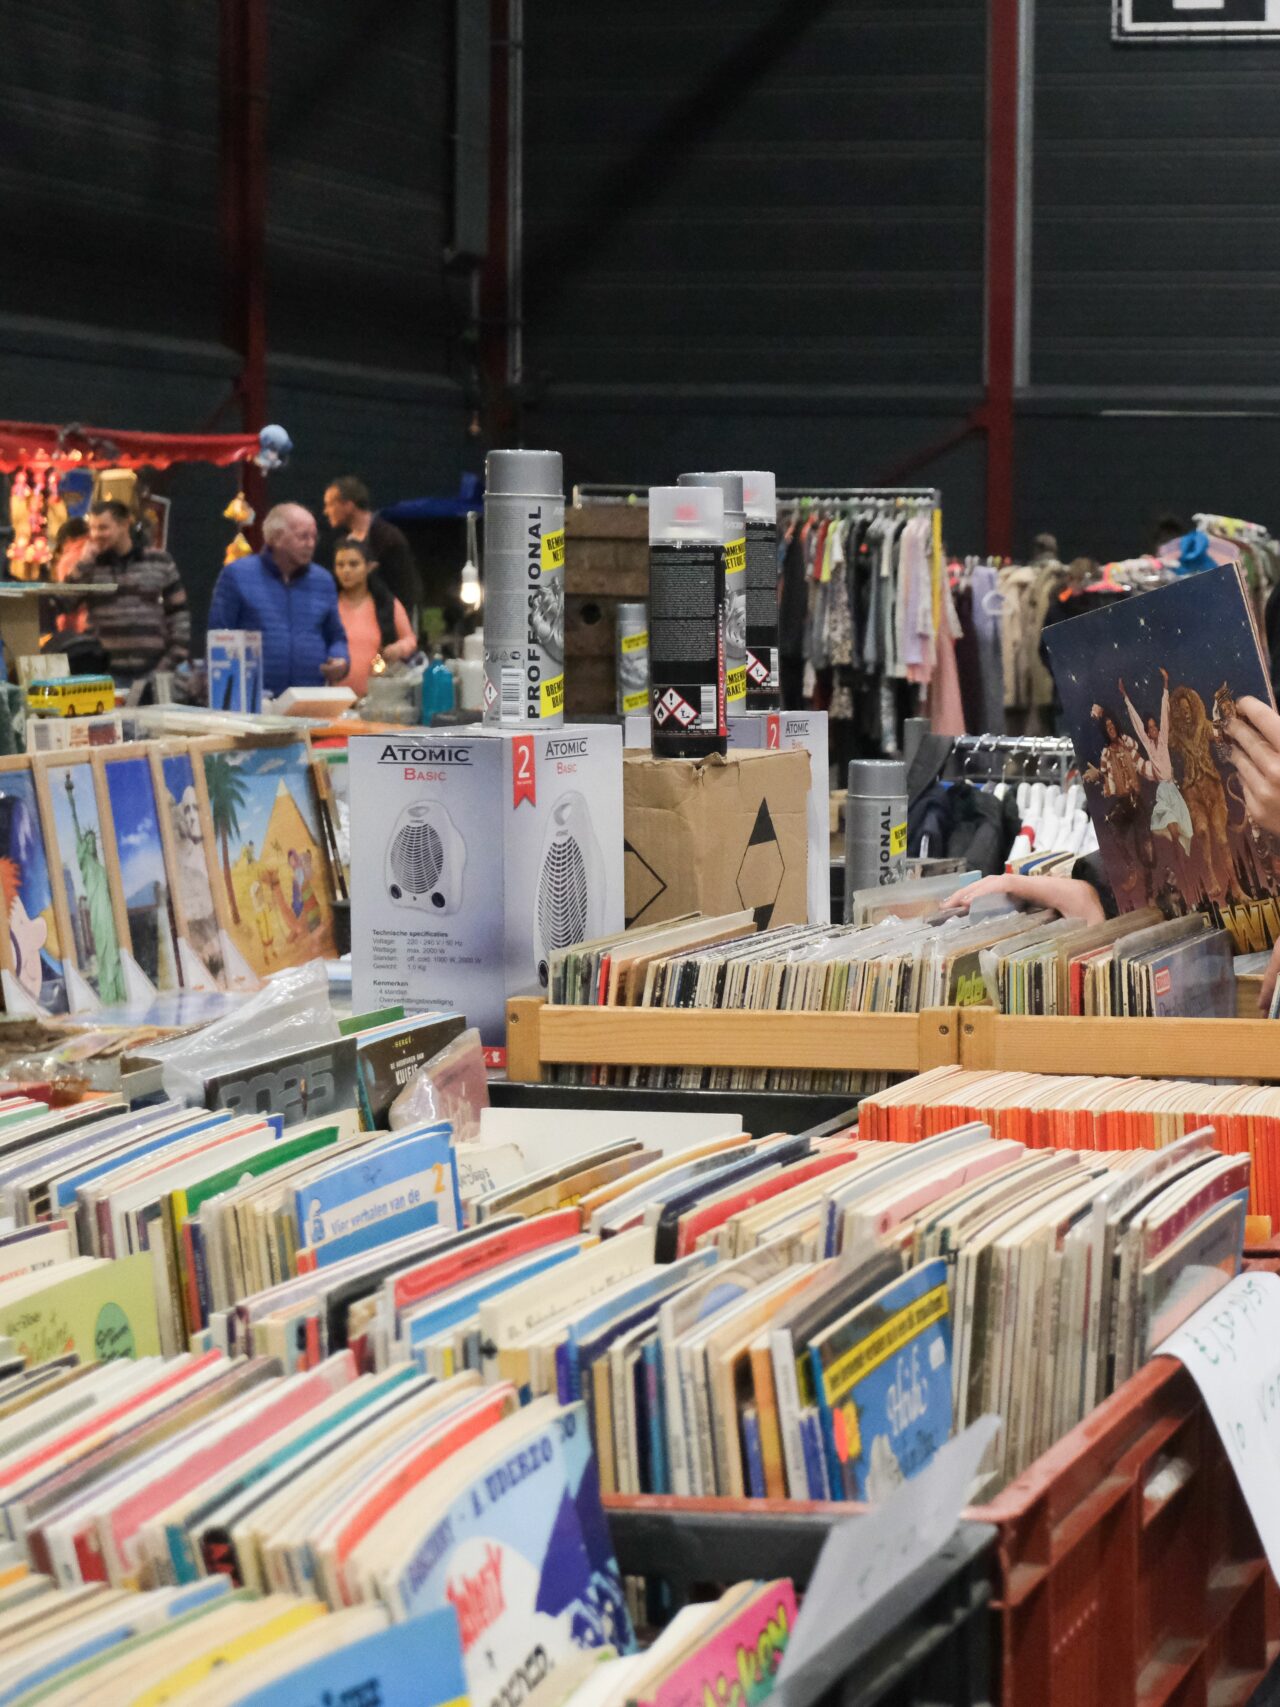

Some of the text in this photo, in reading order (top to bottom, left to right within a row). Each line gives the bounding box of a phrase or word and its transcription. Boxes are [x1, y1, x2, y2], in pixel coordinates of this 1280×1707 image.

[786, 721, 809, 734] ATOMIC
[770, 725, 778, 749] 2
[380, 744, 470, 762] ATOMIC
[545, 740, 587, 756] ATOMIC
[517, 745, 531, 778] 2
[431, 1162, 446, 1194] 2
[407, 1188, 421, 1204] de
